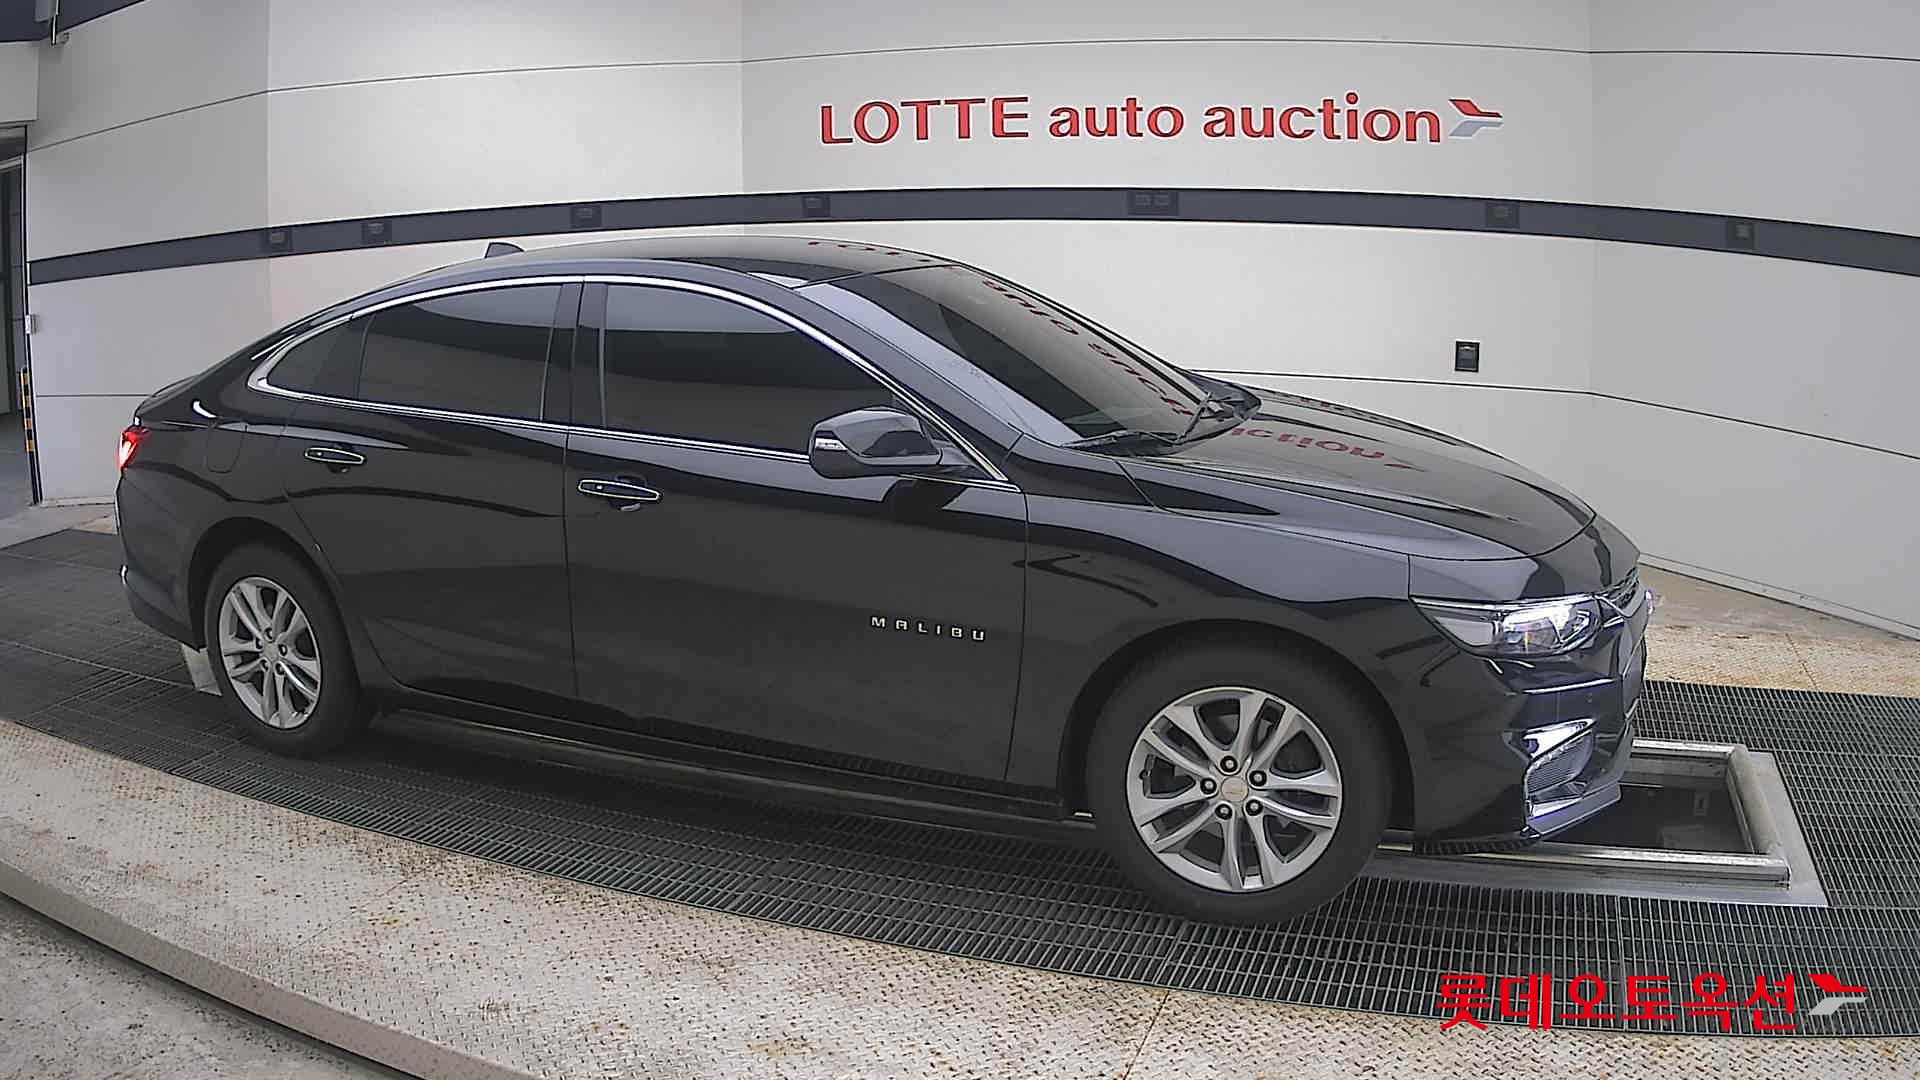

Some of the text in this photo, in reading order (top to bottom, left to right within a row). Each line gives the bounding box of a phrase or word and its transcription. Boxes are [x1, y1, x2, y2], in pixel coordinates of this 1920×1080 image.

[820, 92, 1442, 145] LOTTE auto auction
[871, 616, 985, 641] MALIBU
